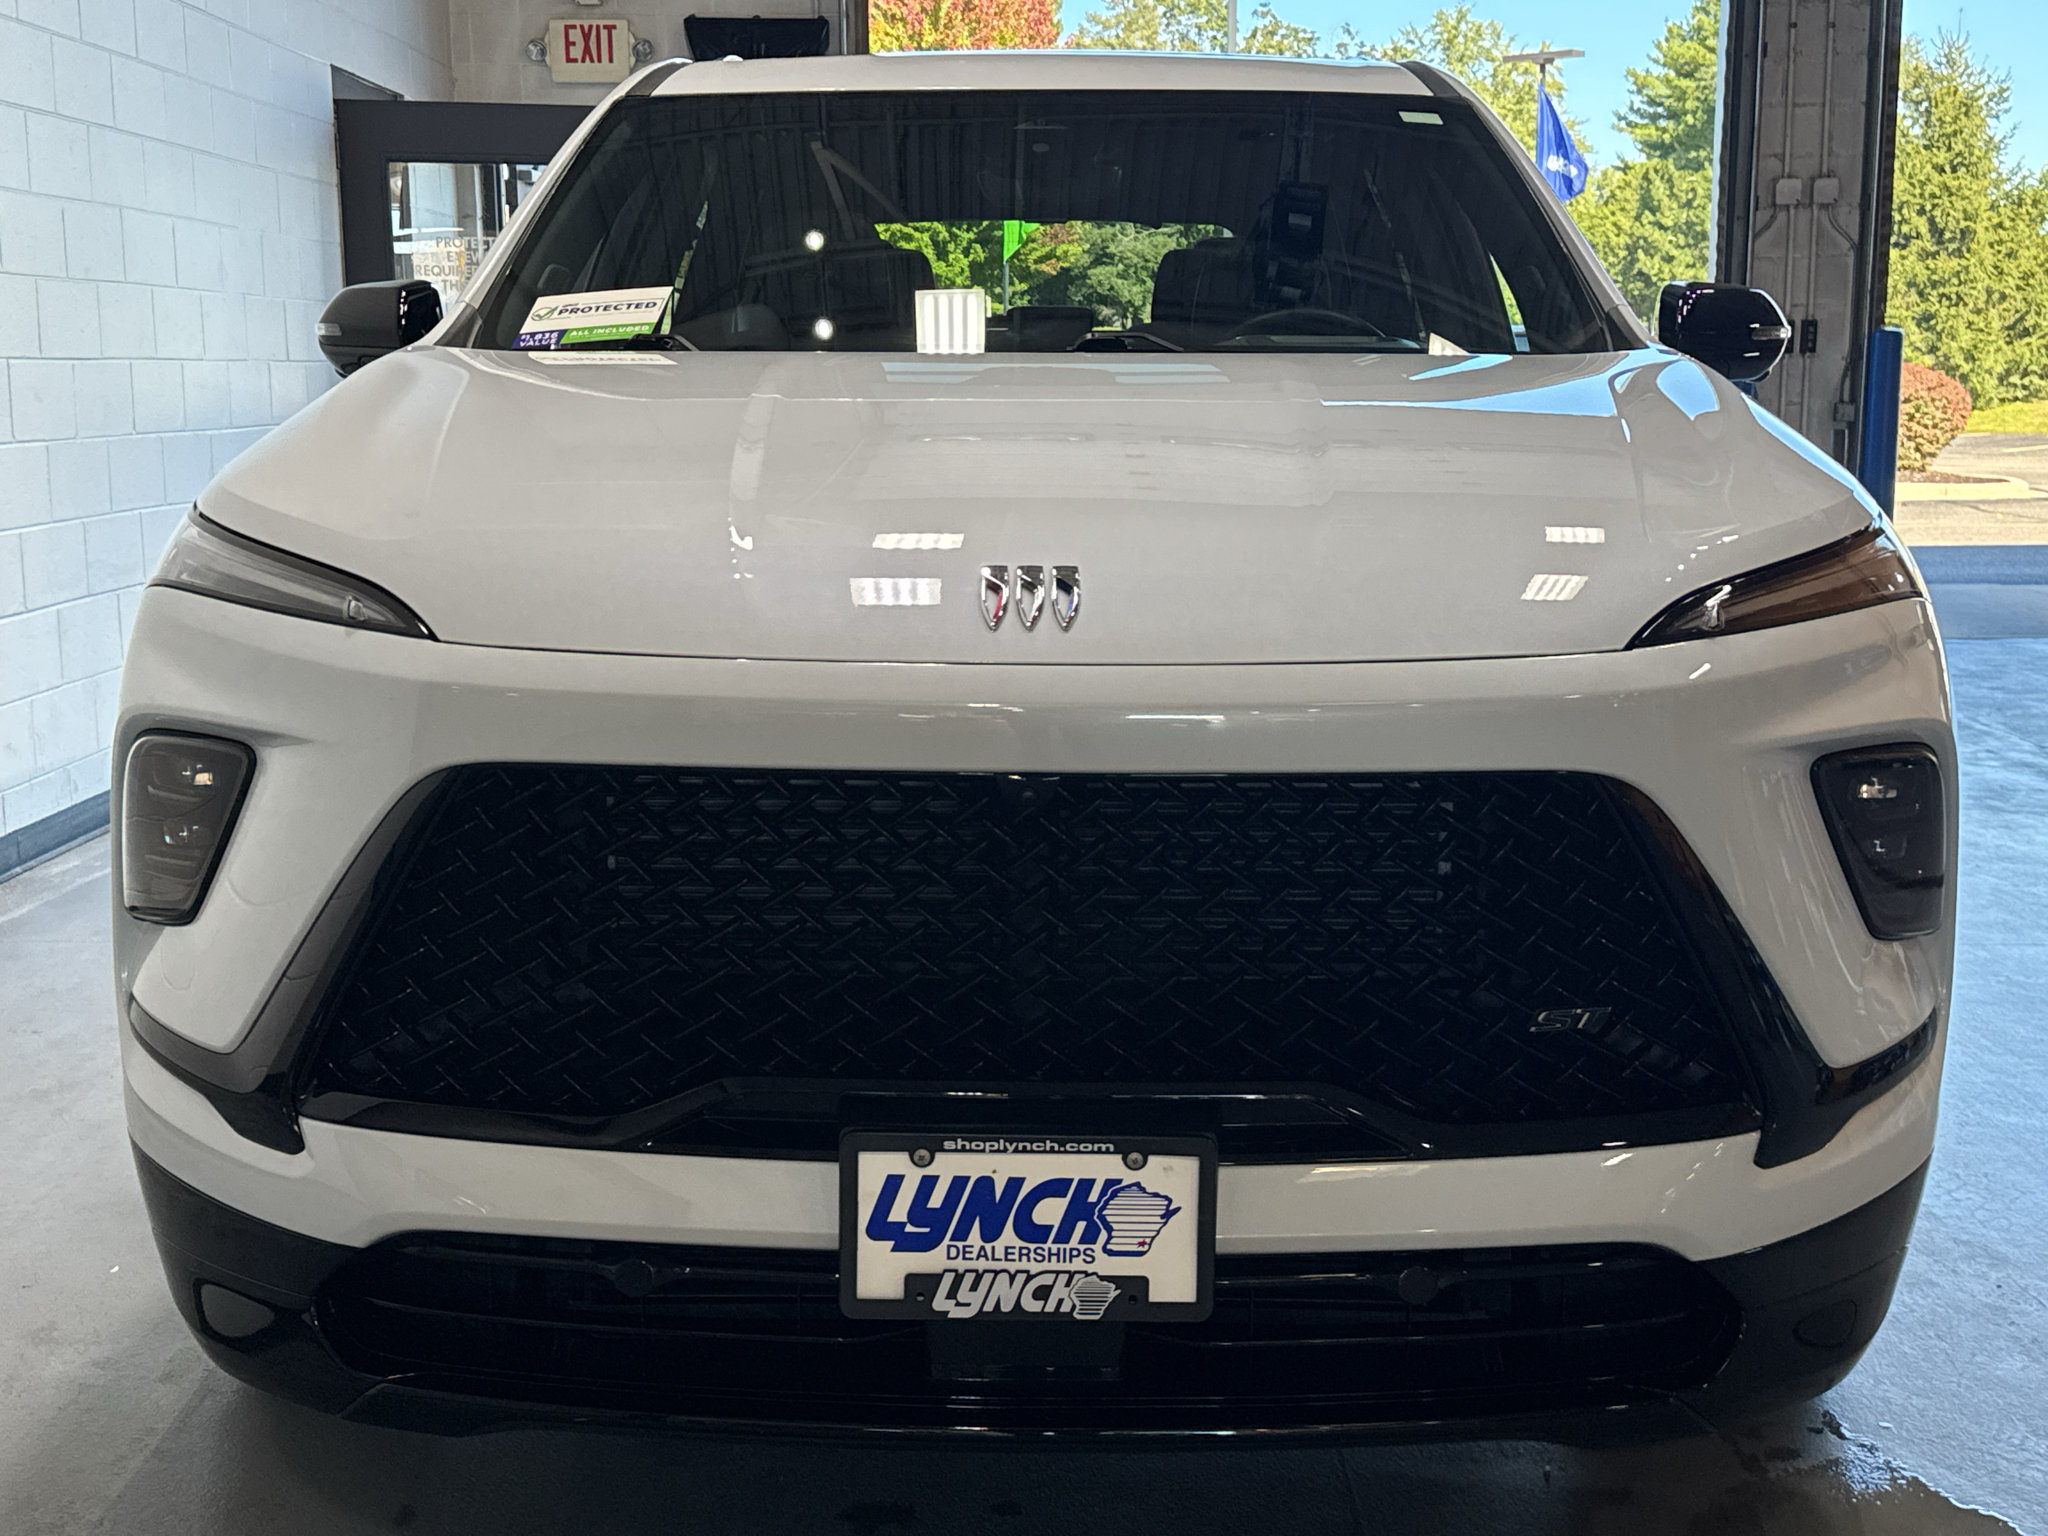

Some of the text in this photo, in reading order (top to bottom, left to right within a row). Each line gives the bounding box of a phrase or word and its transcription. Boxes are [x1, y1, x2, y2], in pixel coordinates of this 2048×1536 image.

[563, 24, 617, 63] EXIT
[557, 301, 658, 316] PROTECTED
[569, 324, 650, 337] ALL INCLUDED
[943, 1138, 1115, 1154] shoplynch.com
[865, 1173, 1123, 1253] LYNCH
[946, 1244, 1096, 1264] DEALERSHIPS
[931, 1269, 1087, 1319] LYNCH
